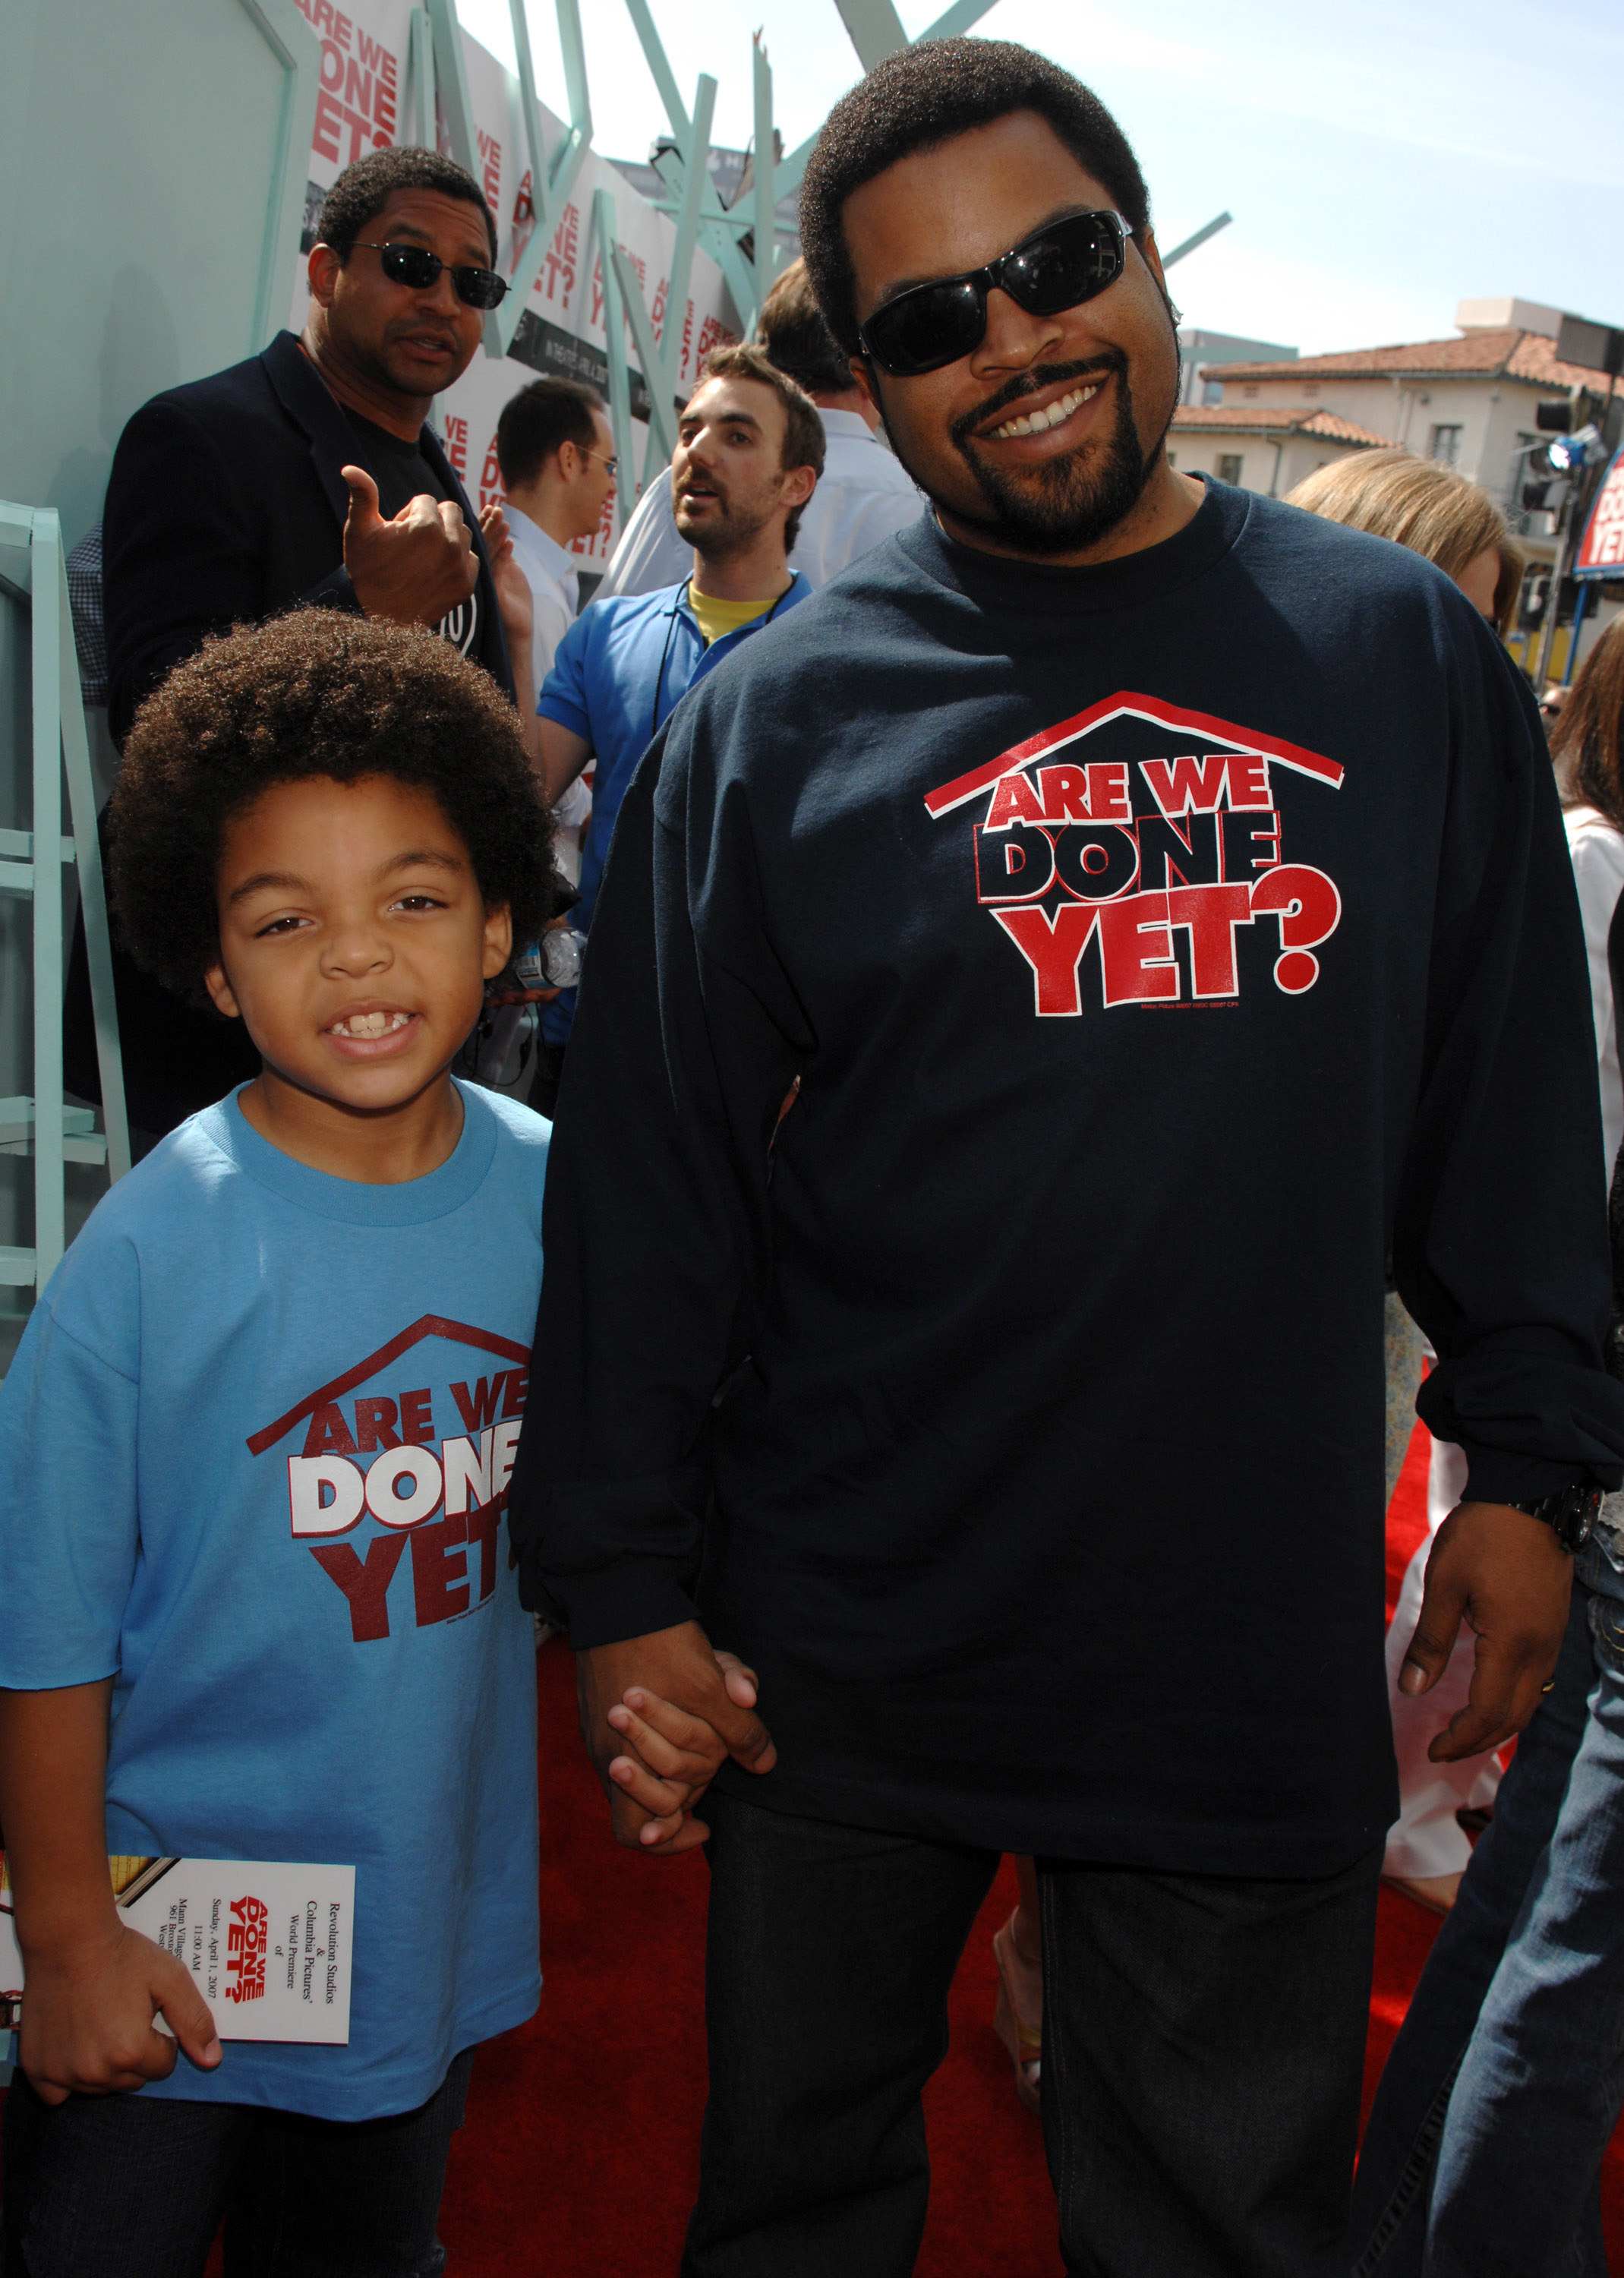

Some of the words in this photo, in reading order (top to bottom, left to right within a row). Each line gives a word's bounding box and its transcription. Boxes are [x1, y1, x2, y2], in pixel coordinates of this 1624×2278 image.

[358, 27, 397, 88] WE
[320, 39, 396, 137] ONE
[311, 87, 393, 165] ET
[982, 762, 1133, 834] ARE
[1138, 755, 1275, 818] WE
[973, 809, 1282, 904] DONE
[989, 863, 1342, 1017] YET?
[301, 1387, 435, 1459] ARE
[449, 1366, 530, 1434] WE
[288, 1418, 524, 1539] DONE
[308, 1490, 518, 1642] YET
[169, 1904, 178, 1920] 961
[178, 1898, 188, 1924] Mann
[210, 1898, 222, 1934] Sunday,
[257, 1901, 268, 1954] ARE
[289, 1914, 299, 1943] World
[305, 1900, 317, 1953] Columbia
[328, 1902, 340, 1961] Revolution
[159, 1924, 168, 1948] West
[168, 1923, 177, 1955] Broxto
[174, 1927, 186, 1959] Village
[194, 1925, 203, 1950] 11:00
[209, 1937, 219, 1961] April
[225, 1895, 247, 2004] YET?
[242, 1896, 260, 2002] DONE
[275, 1945, 283, 1957] of
[317, 1948, 325, 1957] &
[192, 1953, 201, 1970] AM
[255, 1958, 266, 1999] WE
[287, 1947, 298, 1989] Premiere
[208, 1976, 217, 1999] 2007
[326, 1964, 338, 2005] Studios
